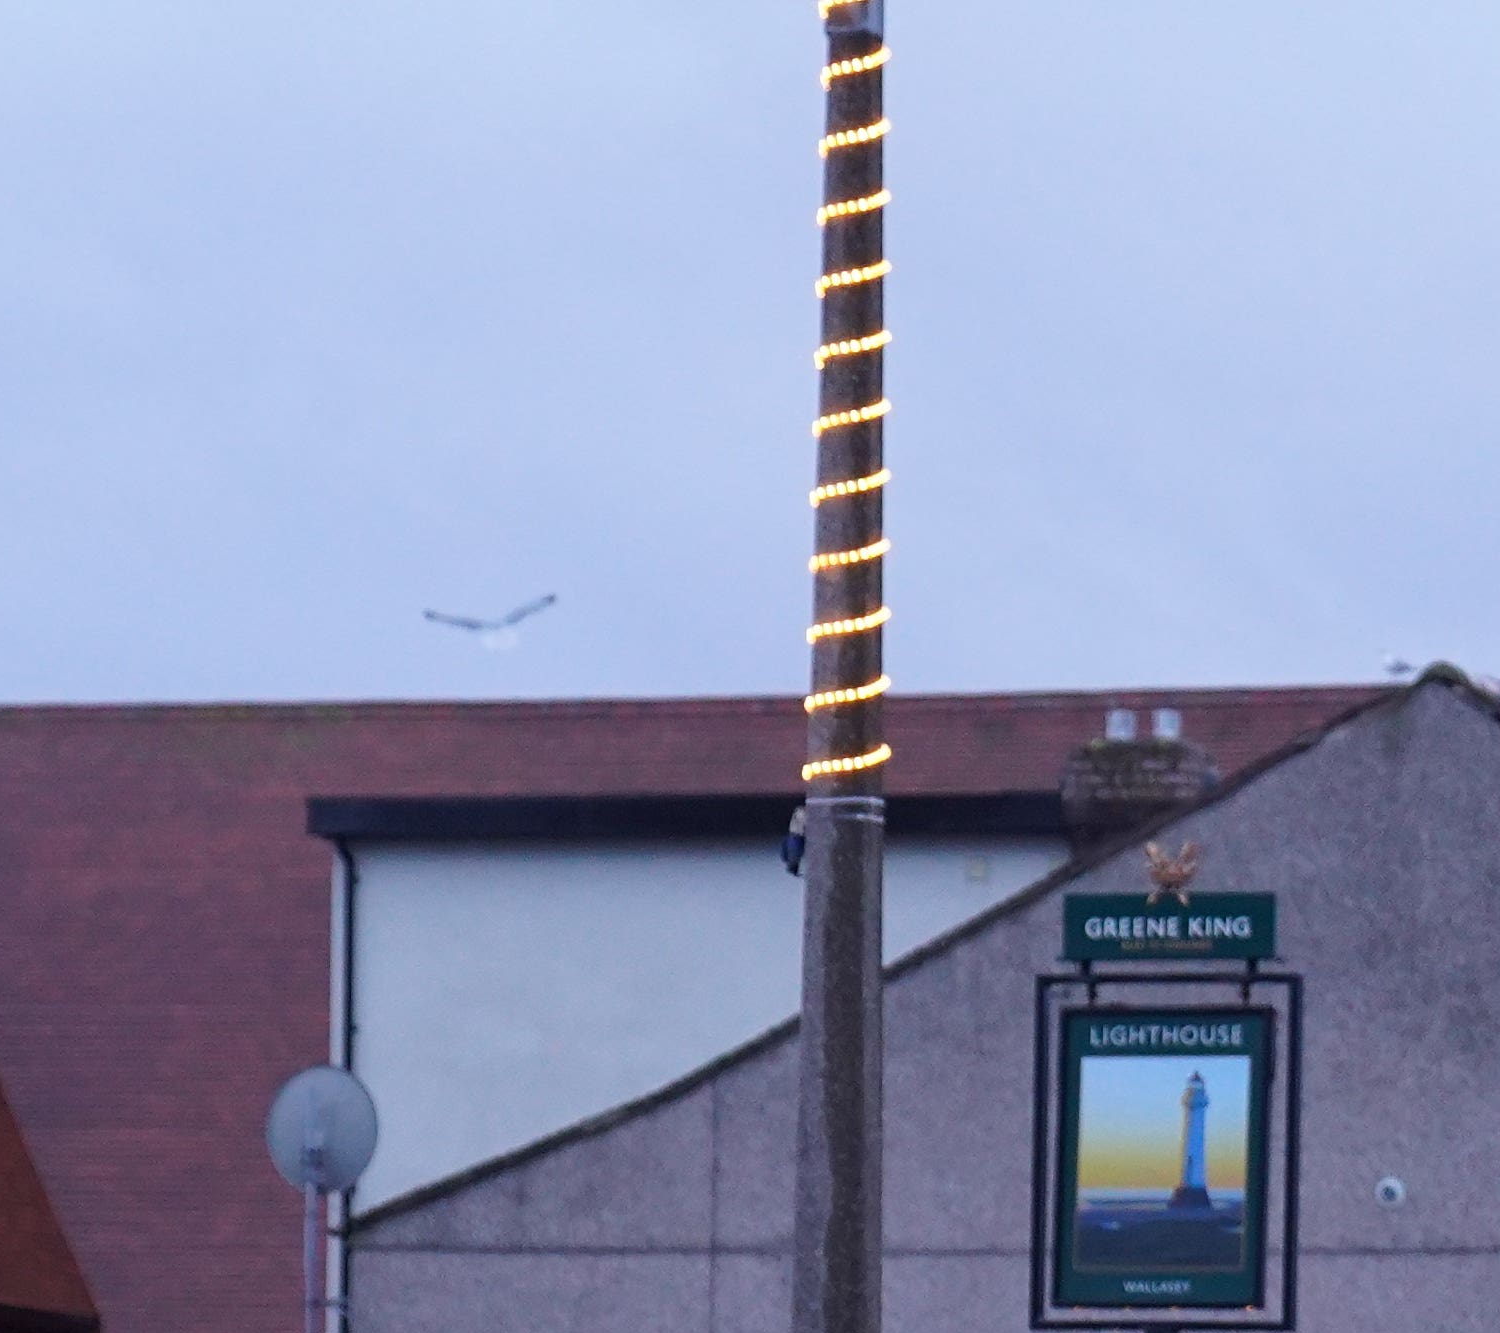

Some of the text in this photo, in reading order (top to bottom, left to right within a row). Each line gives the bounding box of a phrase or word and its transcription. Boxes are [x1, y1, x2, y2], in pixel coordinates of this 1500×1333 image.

[1085, 915, 1251, 940] GREENE KING
[1089, 1023, 1243, 1047] LIGHTHOUSE
